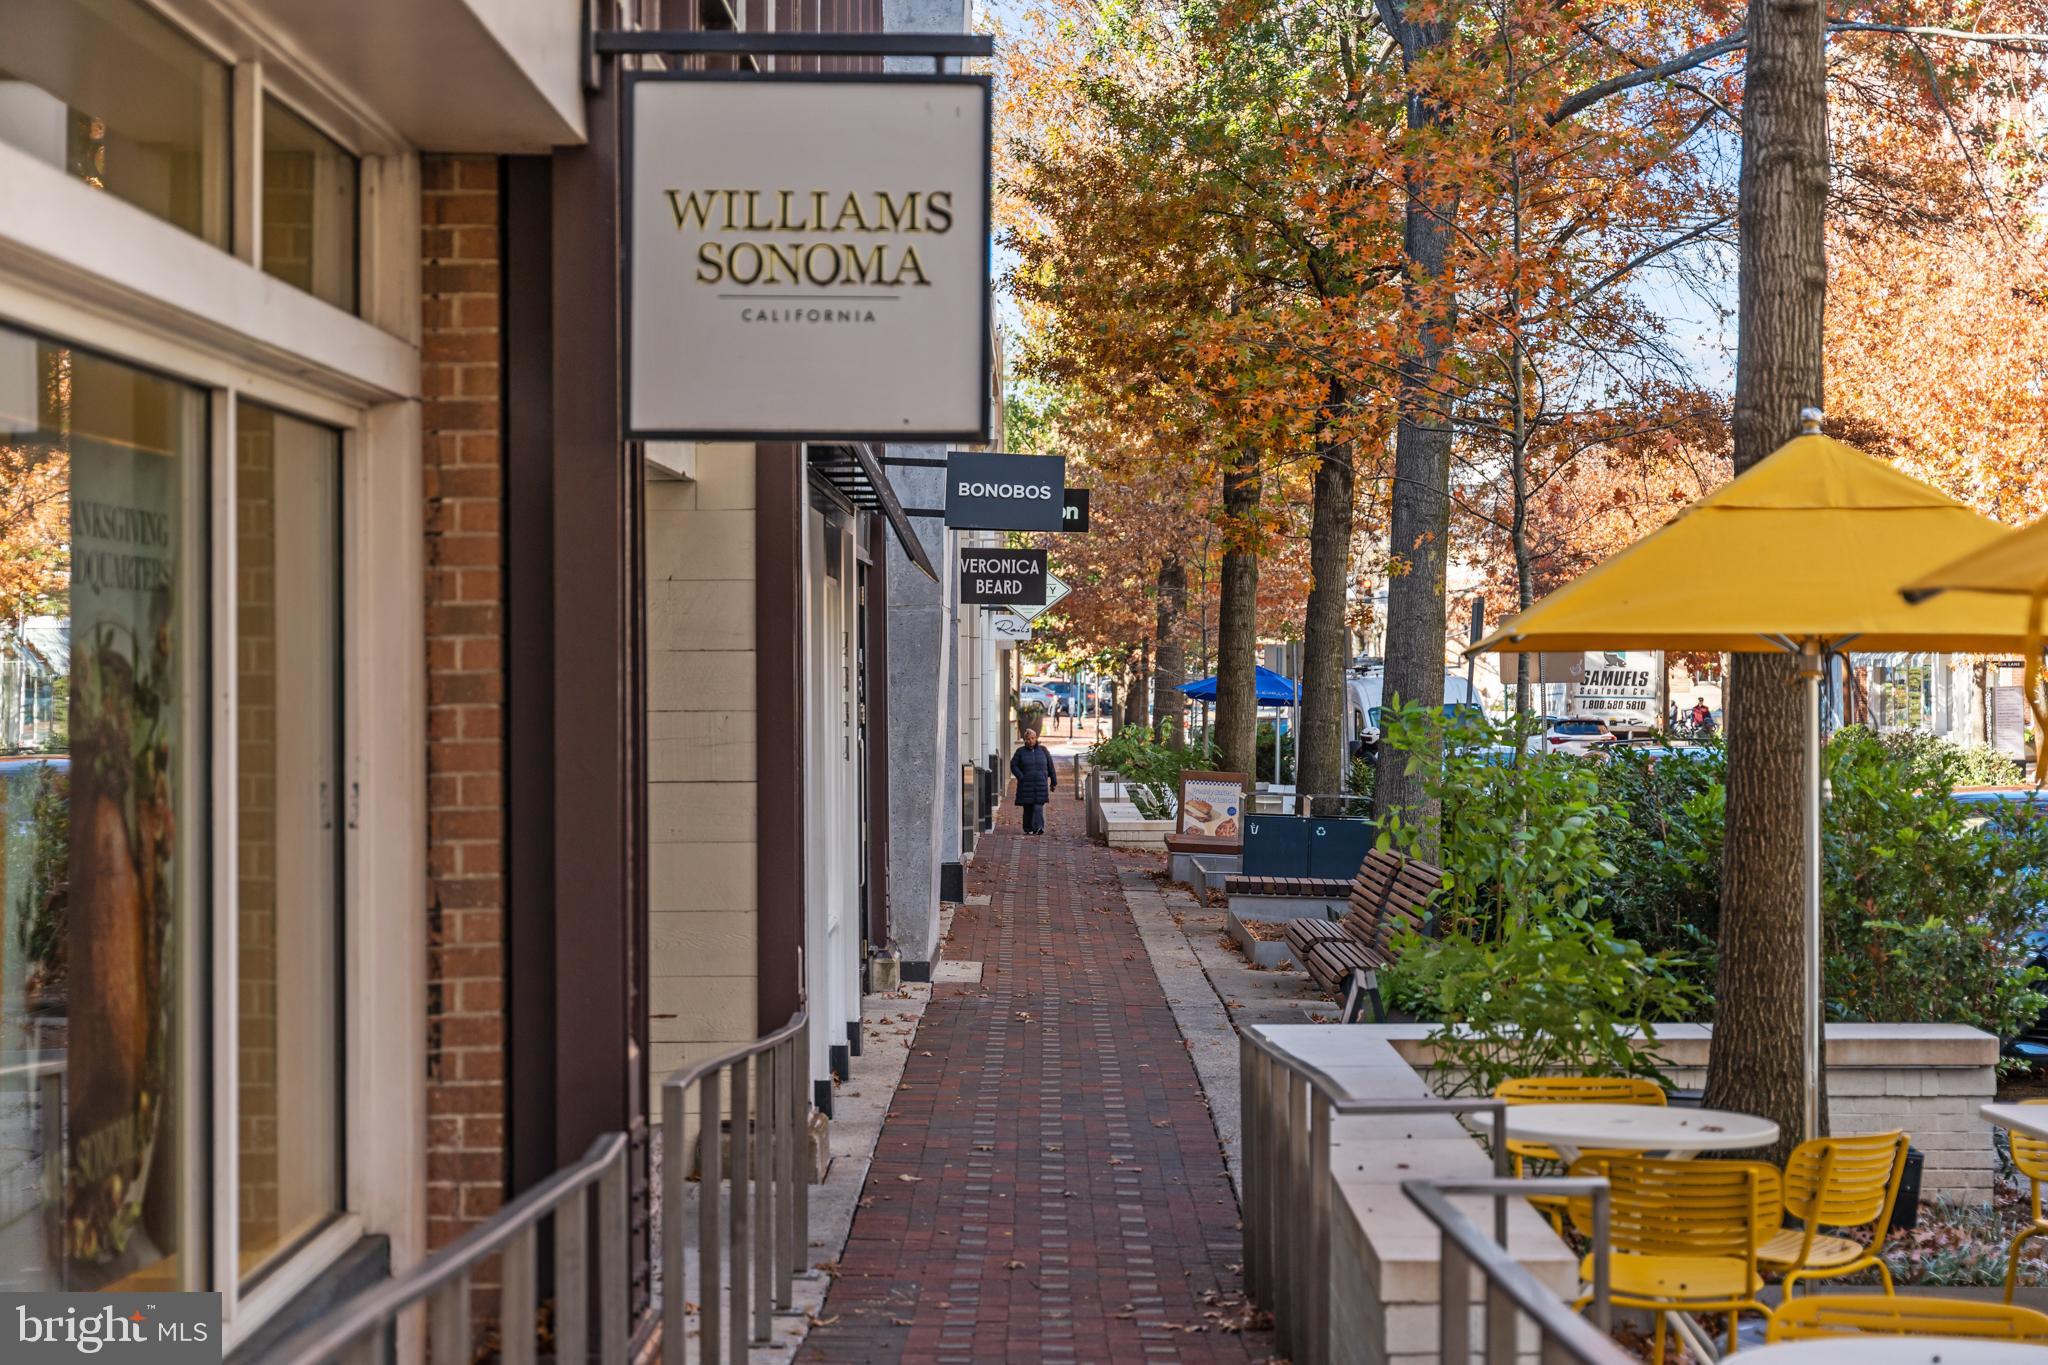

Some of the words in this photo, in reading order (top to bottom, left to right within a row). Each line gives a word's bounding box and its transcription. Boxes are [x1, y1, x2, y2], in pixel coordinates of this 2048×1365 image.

[665, 189, 953, 234] WILLIAMS
[696, 242, 931, 286] SONOMA
[742, 308, 876, 323] CALIFORNIA
[958, 482, 1051, 499] BONOBOS
[961, 558, 1040, 575] VERONICA
[976, 579, 1022, 594] BEARD
[995, 619, 1030, 636] Rails
[1580, 670, 1649, 686] SAMUELS
[1580, 687, 1625, 695] Seafood
[1582, 700, 1646, 710] 1.800.580.5810
